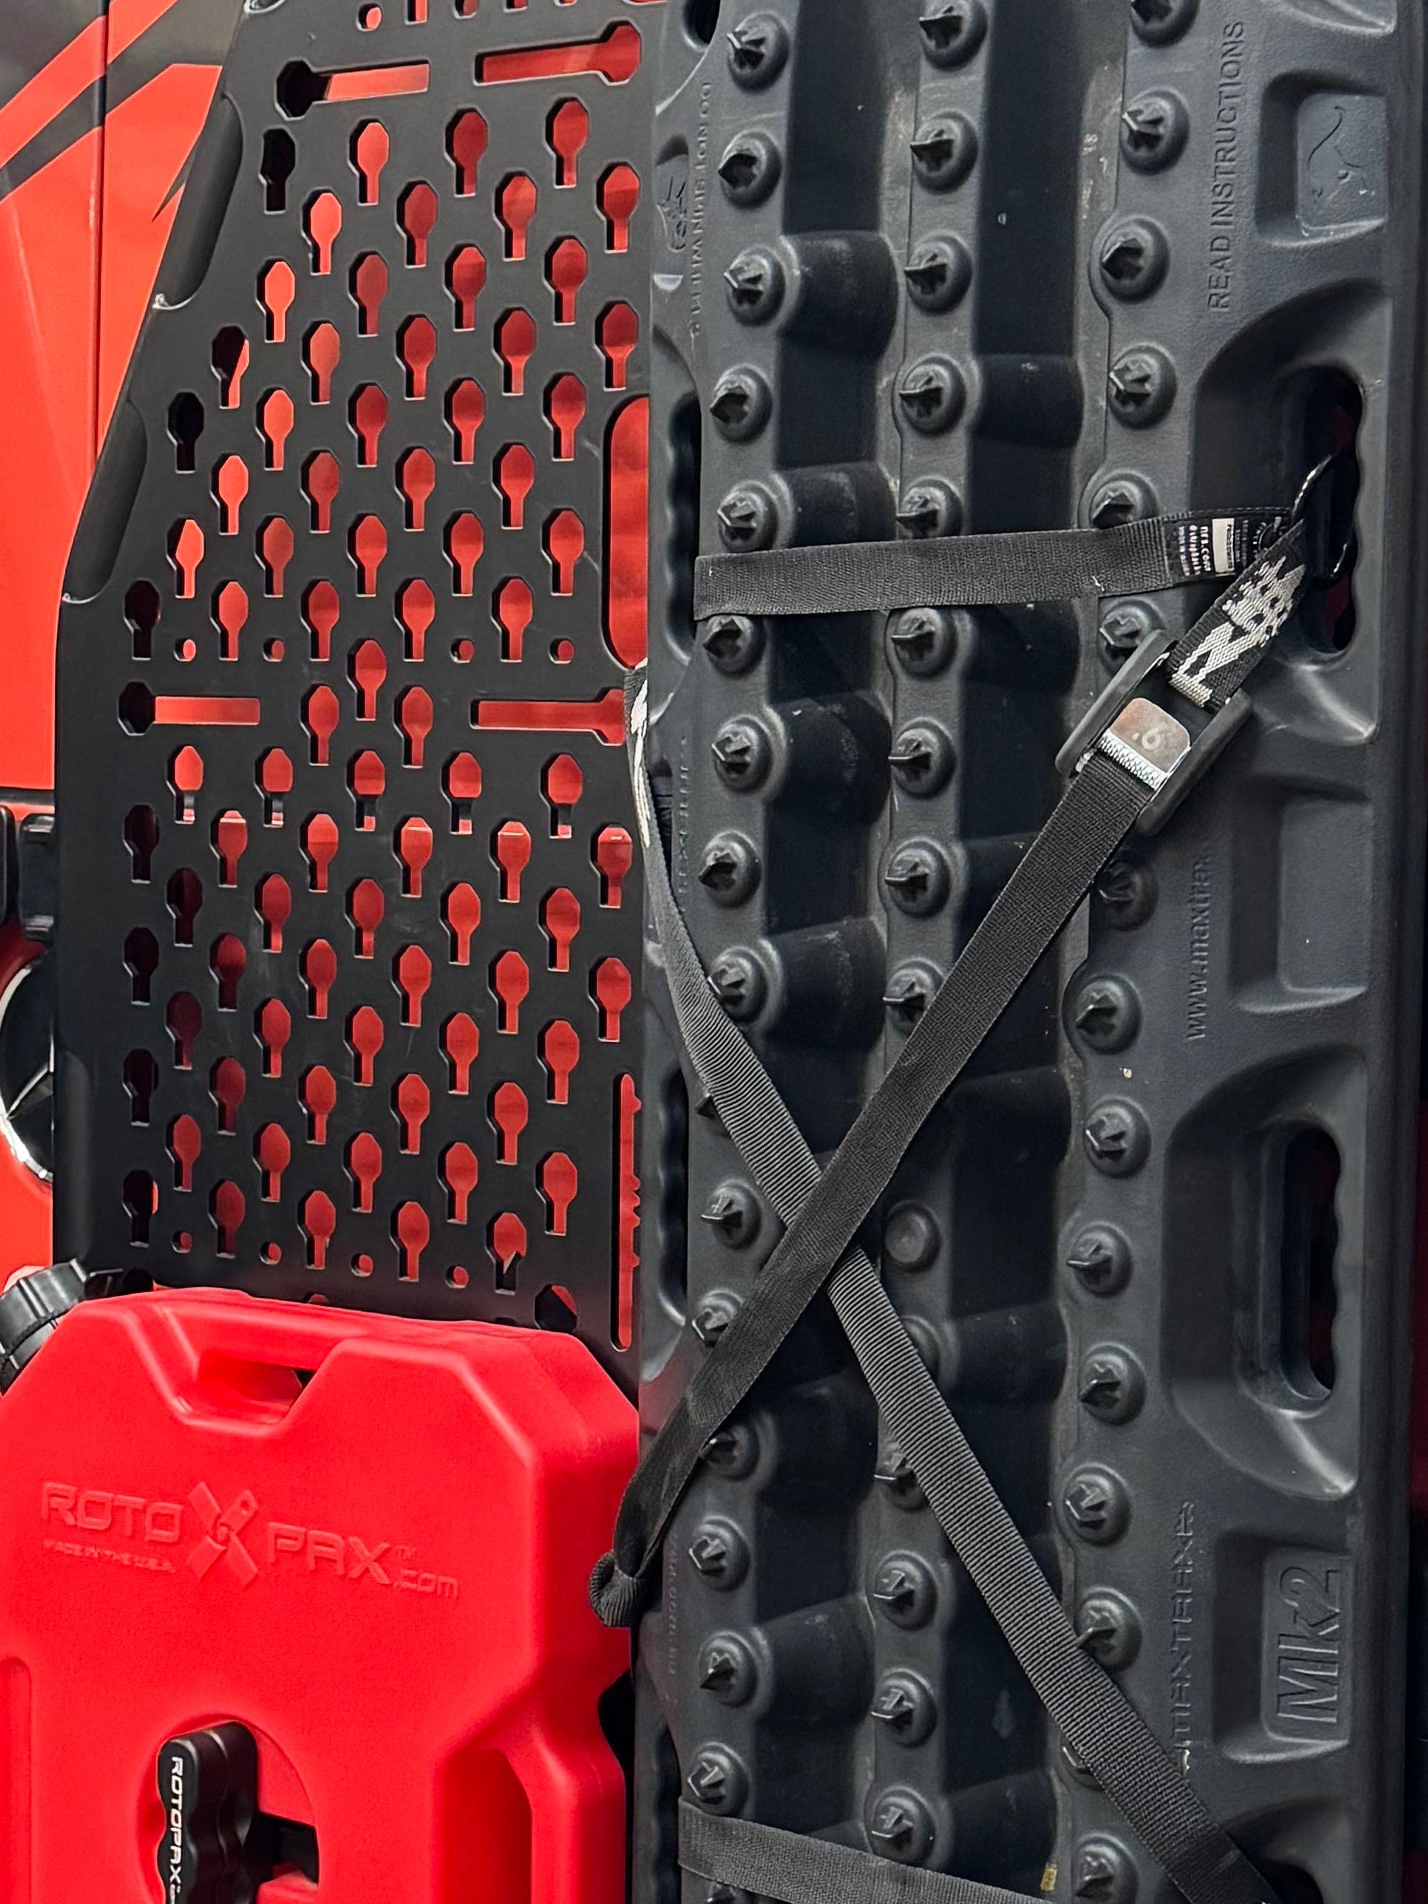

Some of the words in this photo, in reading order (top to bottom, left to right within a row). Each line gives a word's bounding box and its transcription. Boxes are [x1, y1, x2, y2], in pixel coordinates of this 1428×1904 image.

[1210, 19, 1245, 227] INSTRUCTIONS
[1207, 234, 1233, 311] READ
[41, 1482, 183, 1543] ROTO
[1276, 1565, 1341, 1723] Mk2
